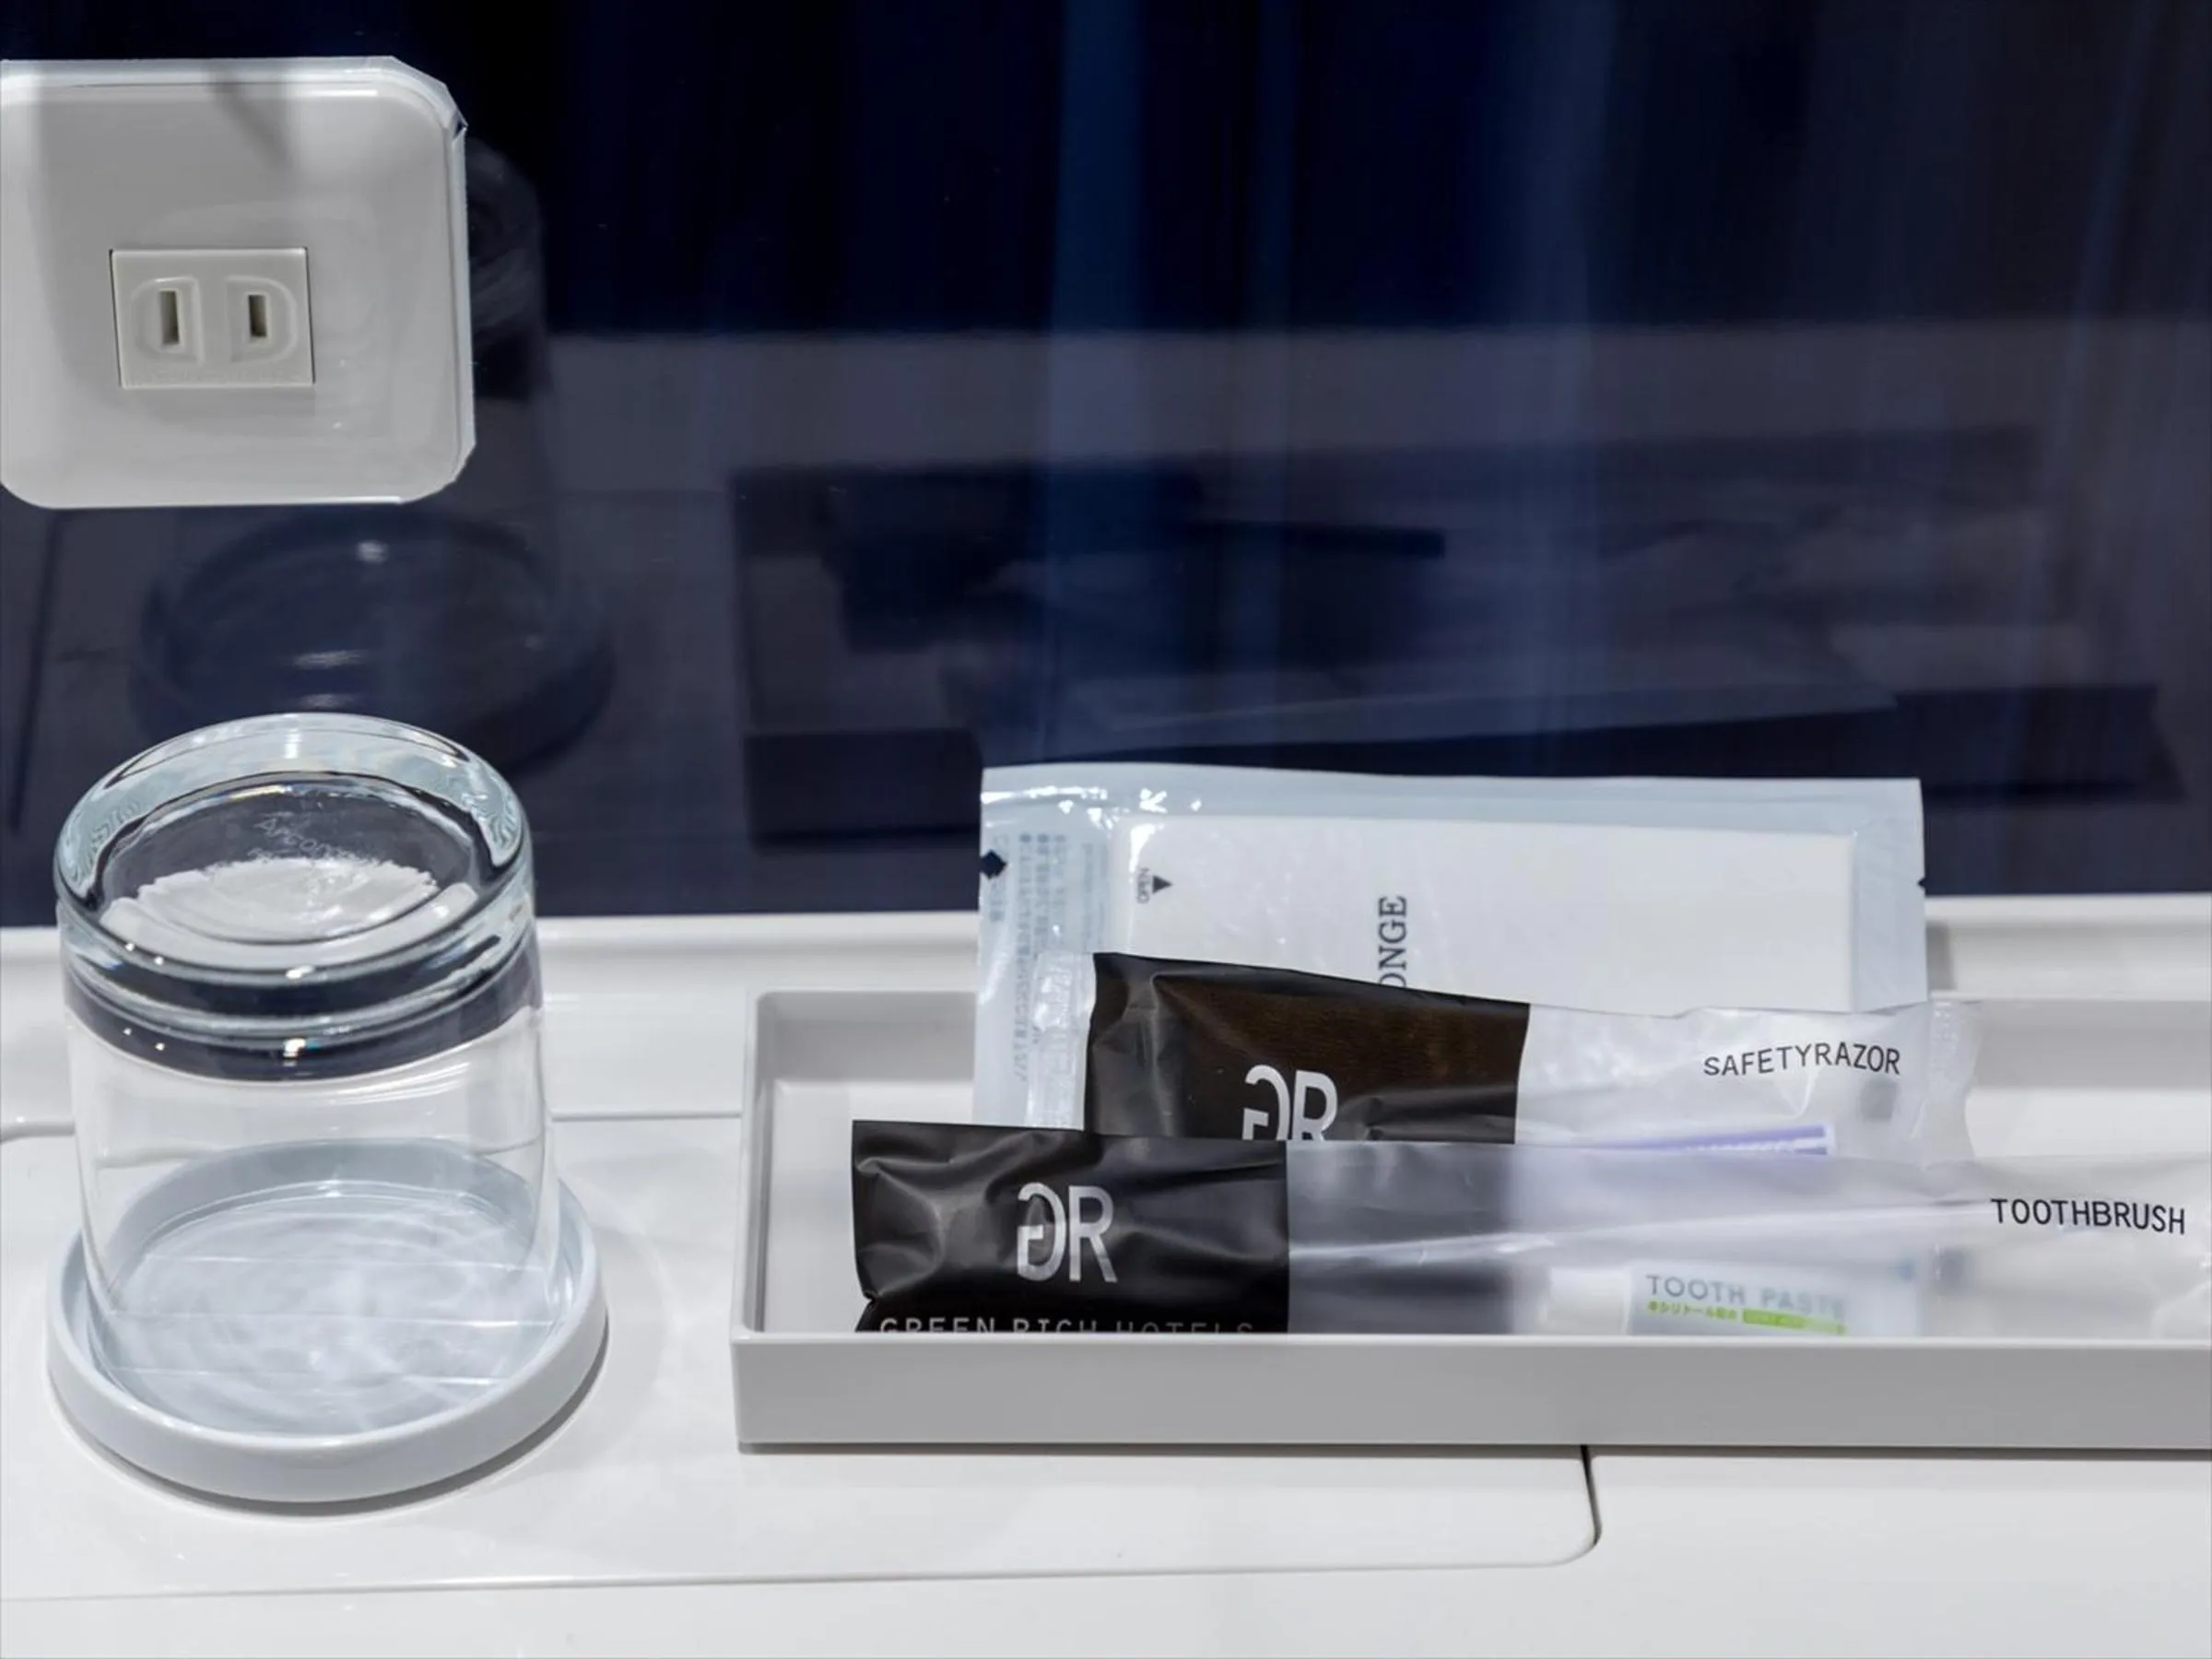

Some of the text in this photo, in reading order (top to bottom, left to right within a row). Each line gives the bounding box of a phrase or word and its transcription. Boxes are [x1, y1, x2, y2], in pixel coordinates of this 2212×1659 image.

[1704, 1041, 1900, 1076] SAFETYRAZOR
[1991, 1198, 2185, 1235] TOOTHBRUSH
[1646, 1275, 1746, 1305] TOOTH
